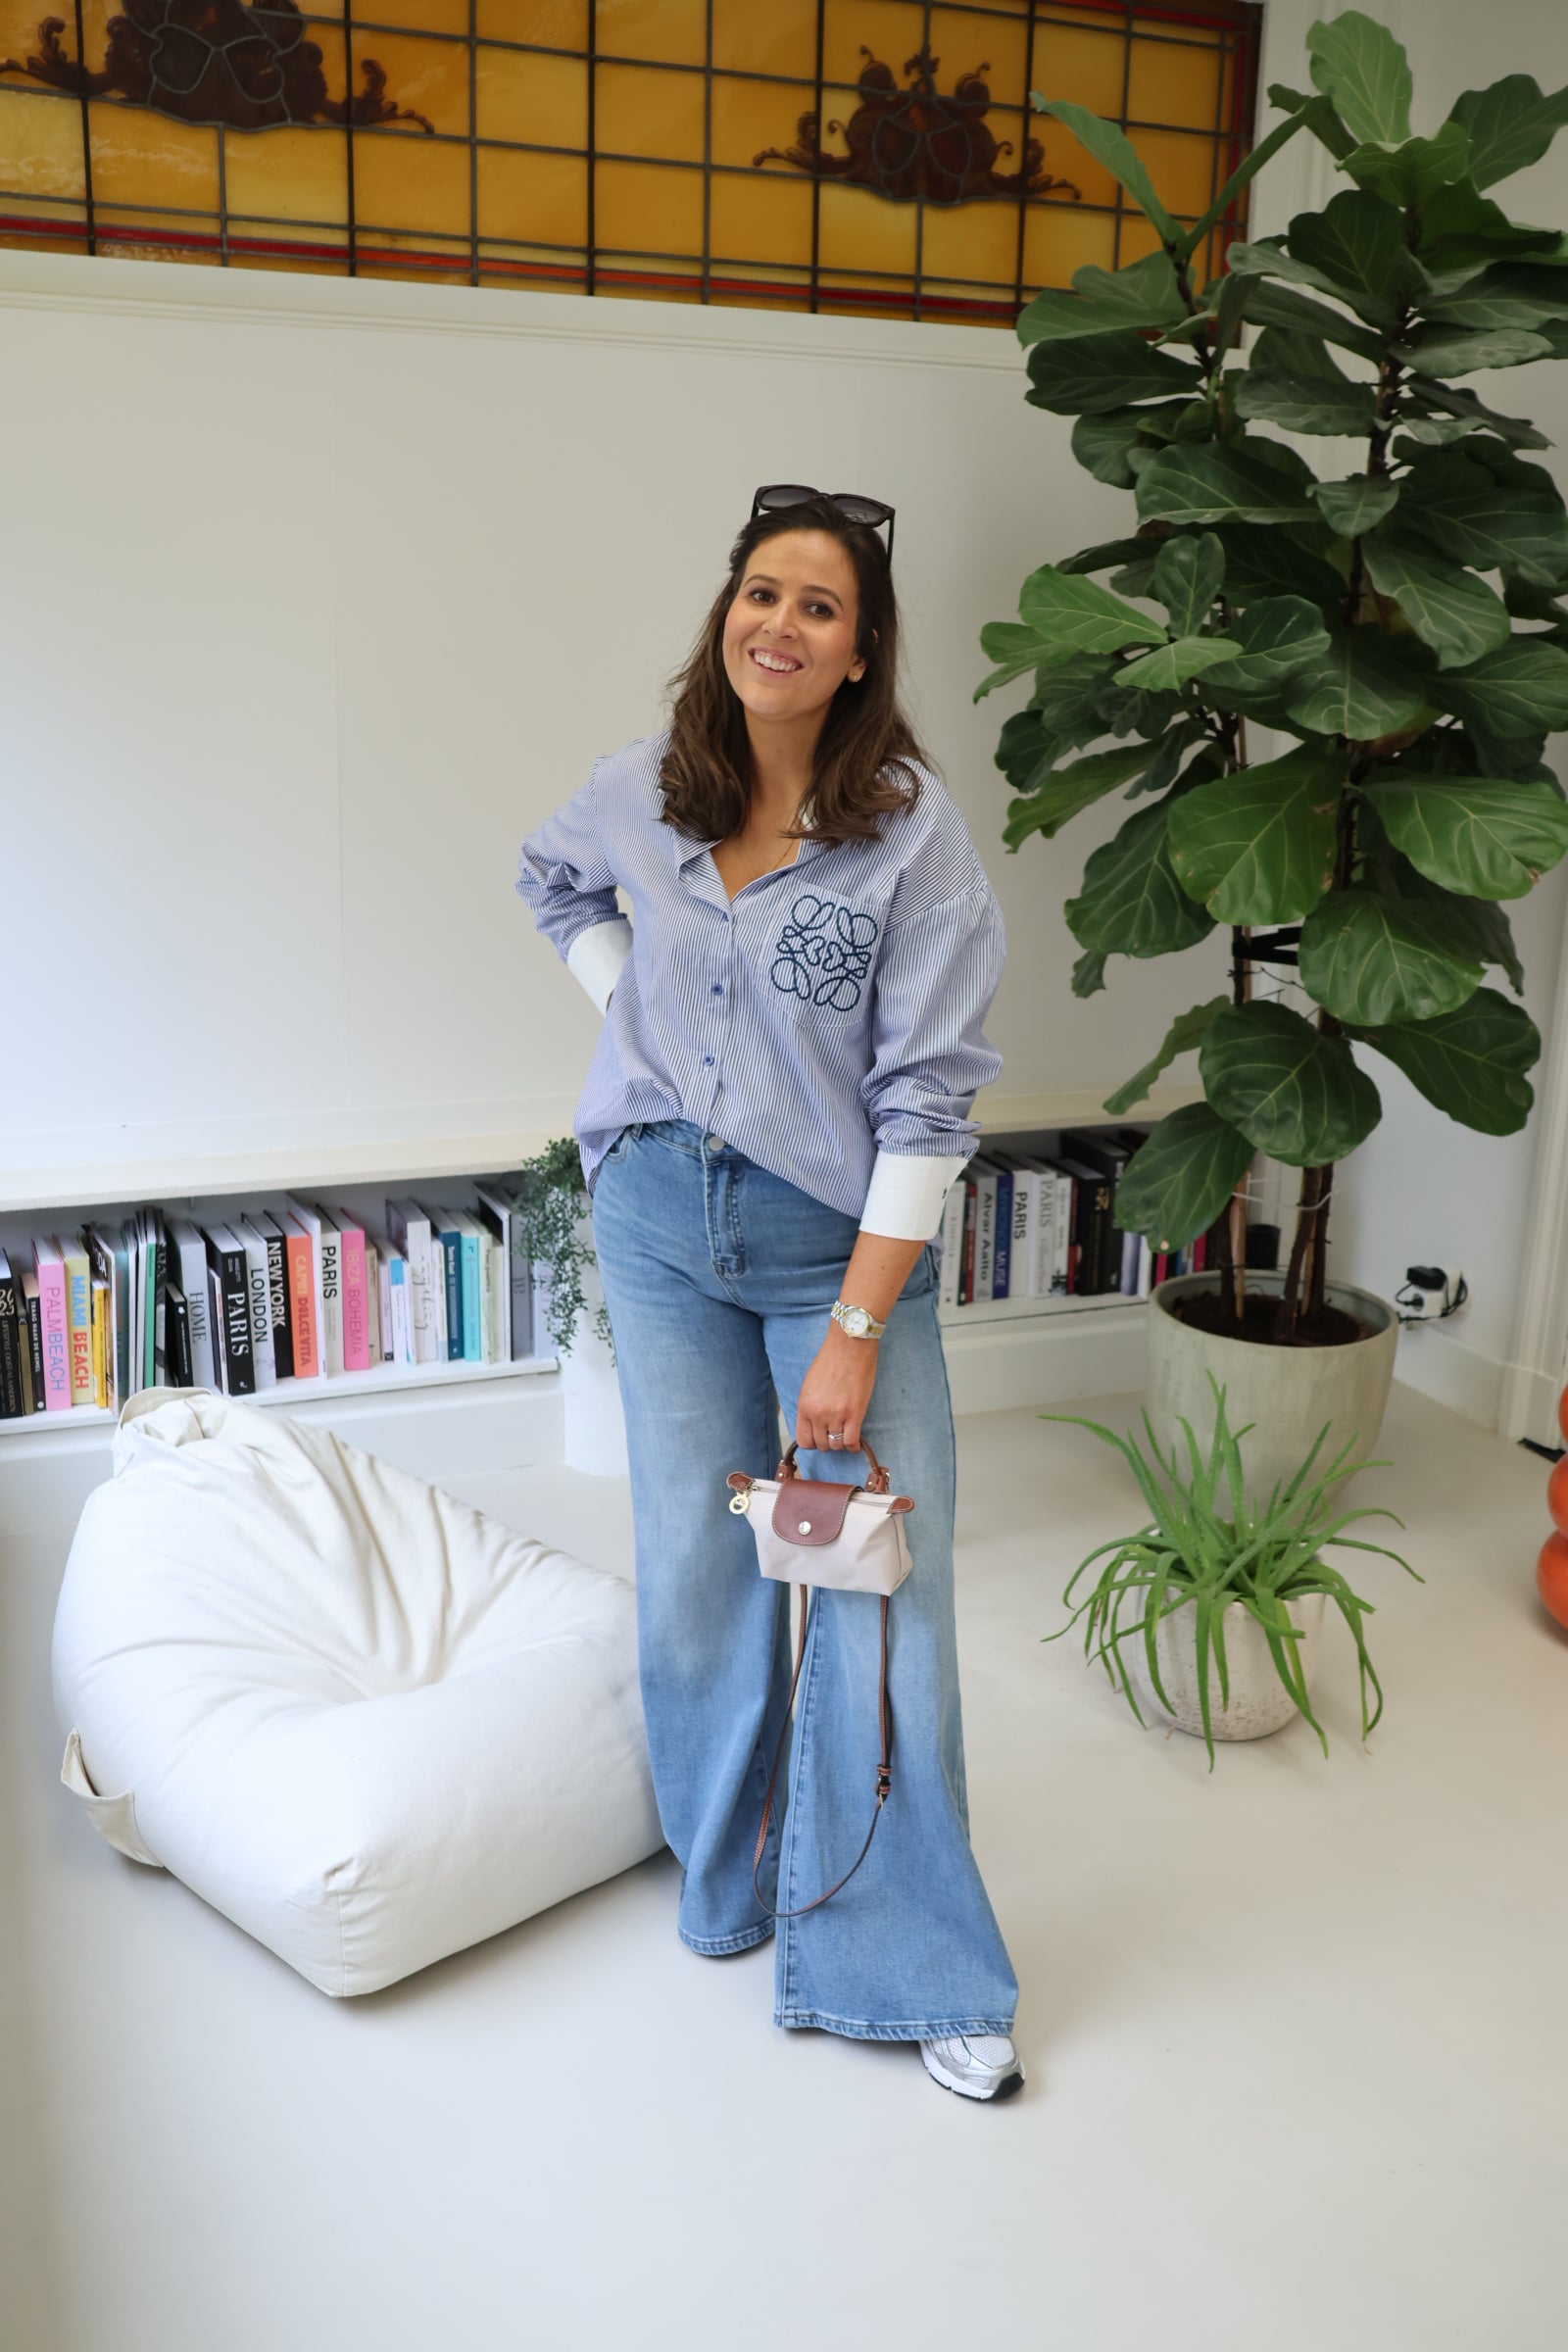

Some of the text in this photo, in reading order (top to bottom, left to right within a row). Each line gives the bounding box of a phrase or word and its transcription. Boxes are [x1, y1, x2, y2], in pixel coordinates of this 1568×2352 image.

[1013, 1191, 1028, 1240] PARIS
[1039, 1180, 1054, 1228] PARIS
[980, 1193, 993, 1281] Alvar Aalto
[995, 1250, 1006, 1287] MUSE
[322, 1246, 337, 1299] PARIS
[346, 1250, 362, 1355] IBIZA BOHEMIA
[72, 1275, 89, 1389] MIAMI BEACH
[190, 1292, 206, 1344] HOME
[227, 1292, 249, 1356] PARIS
[251, 1268, 268, 1343] LONDON
[295, 1254, 311, 1366] CAPRI DOLCE VITA
